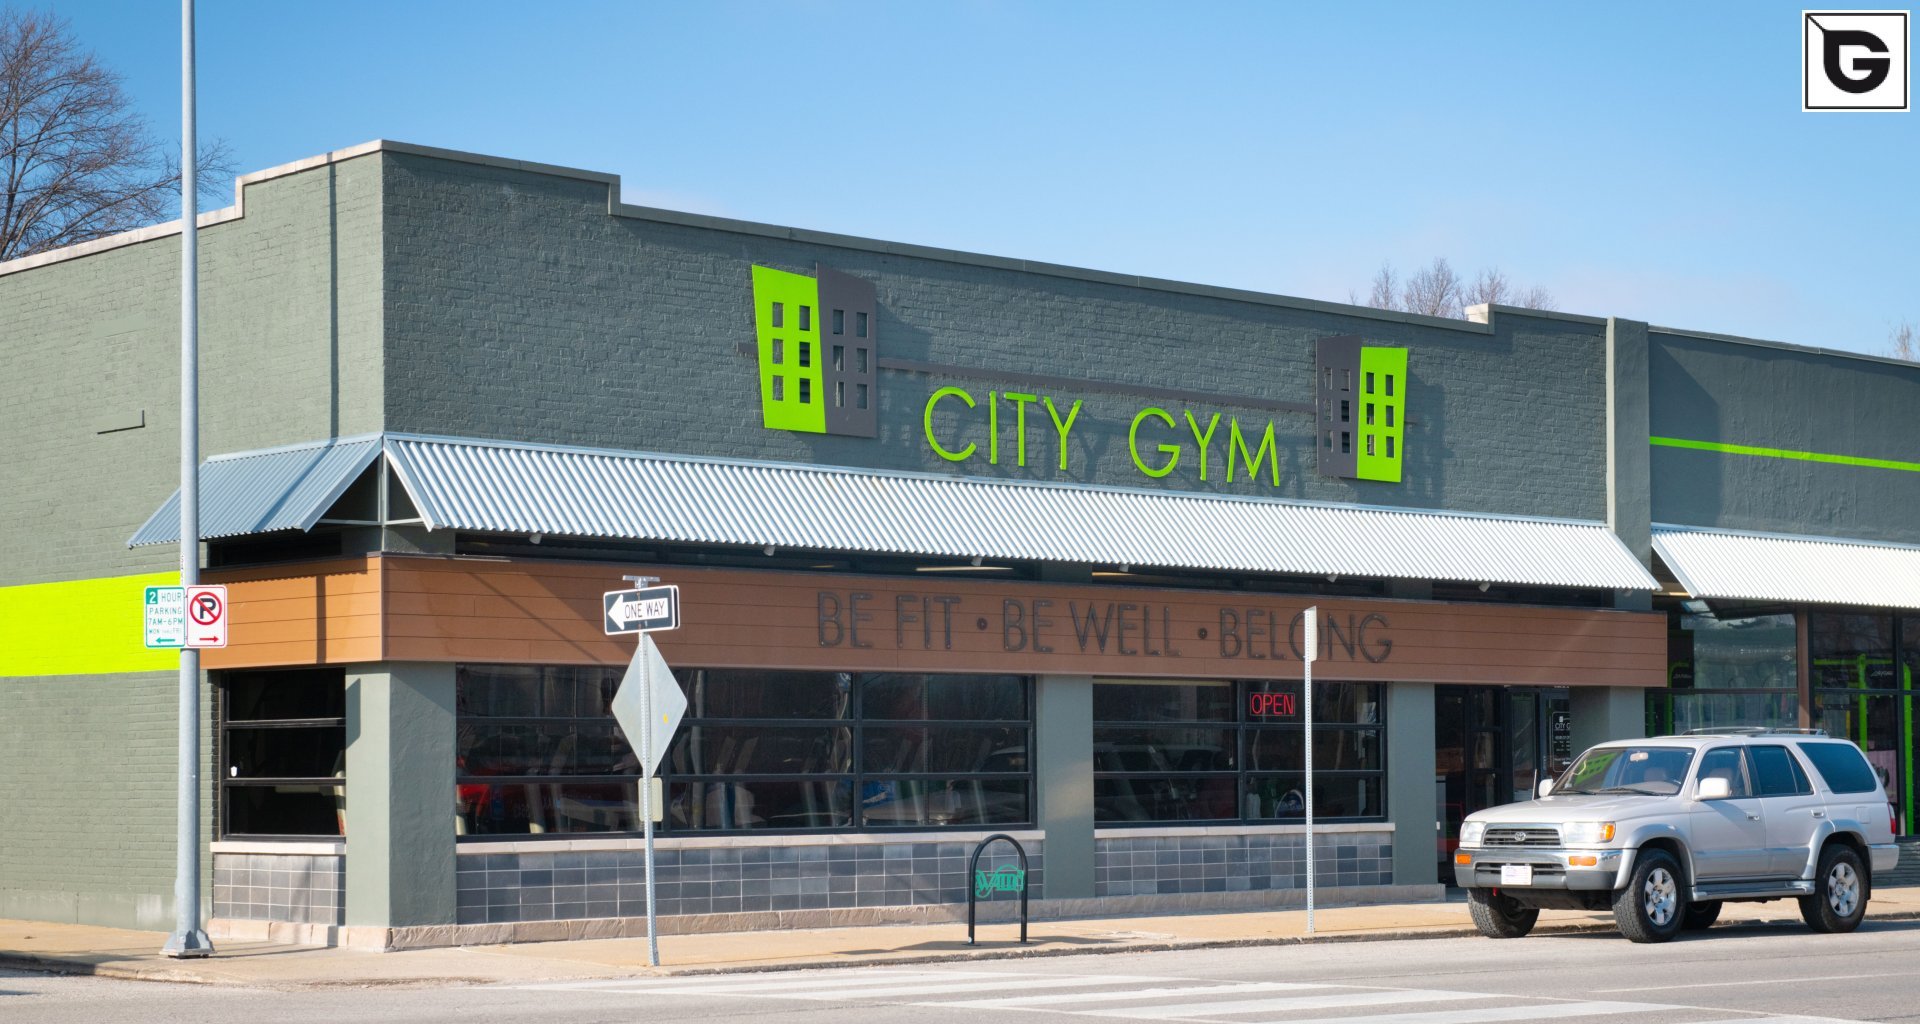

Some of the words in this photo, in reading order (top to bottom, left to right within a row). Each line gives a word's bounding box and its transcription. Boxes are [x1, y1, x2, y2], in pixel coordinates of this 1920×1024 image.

[924, 386, 1083, 470] CITY
[1129, 407, 1280, 487] GYM
[149, 591, 157, 604] 2
[161, 592, 182, 602] HOUR
[149, 607, 183, 615] PARKING
[624, 603, 642, 619] ONE
[646, 600, 664, 617] WAY
[148, 617, 183, 626] 7AM-6PM
[818, 591, 873, 649] BE
[897, 595, 961, 650] FIT
[1003, 599, 1055, 654] BE
[1069, 601, 1182, 657] WELL
[1219, 607, 1393, 663] BELONG
[1251, 693, 1294, 715] OPEN
